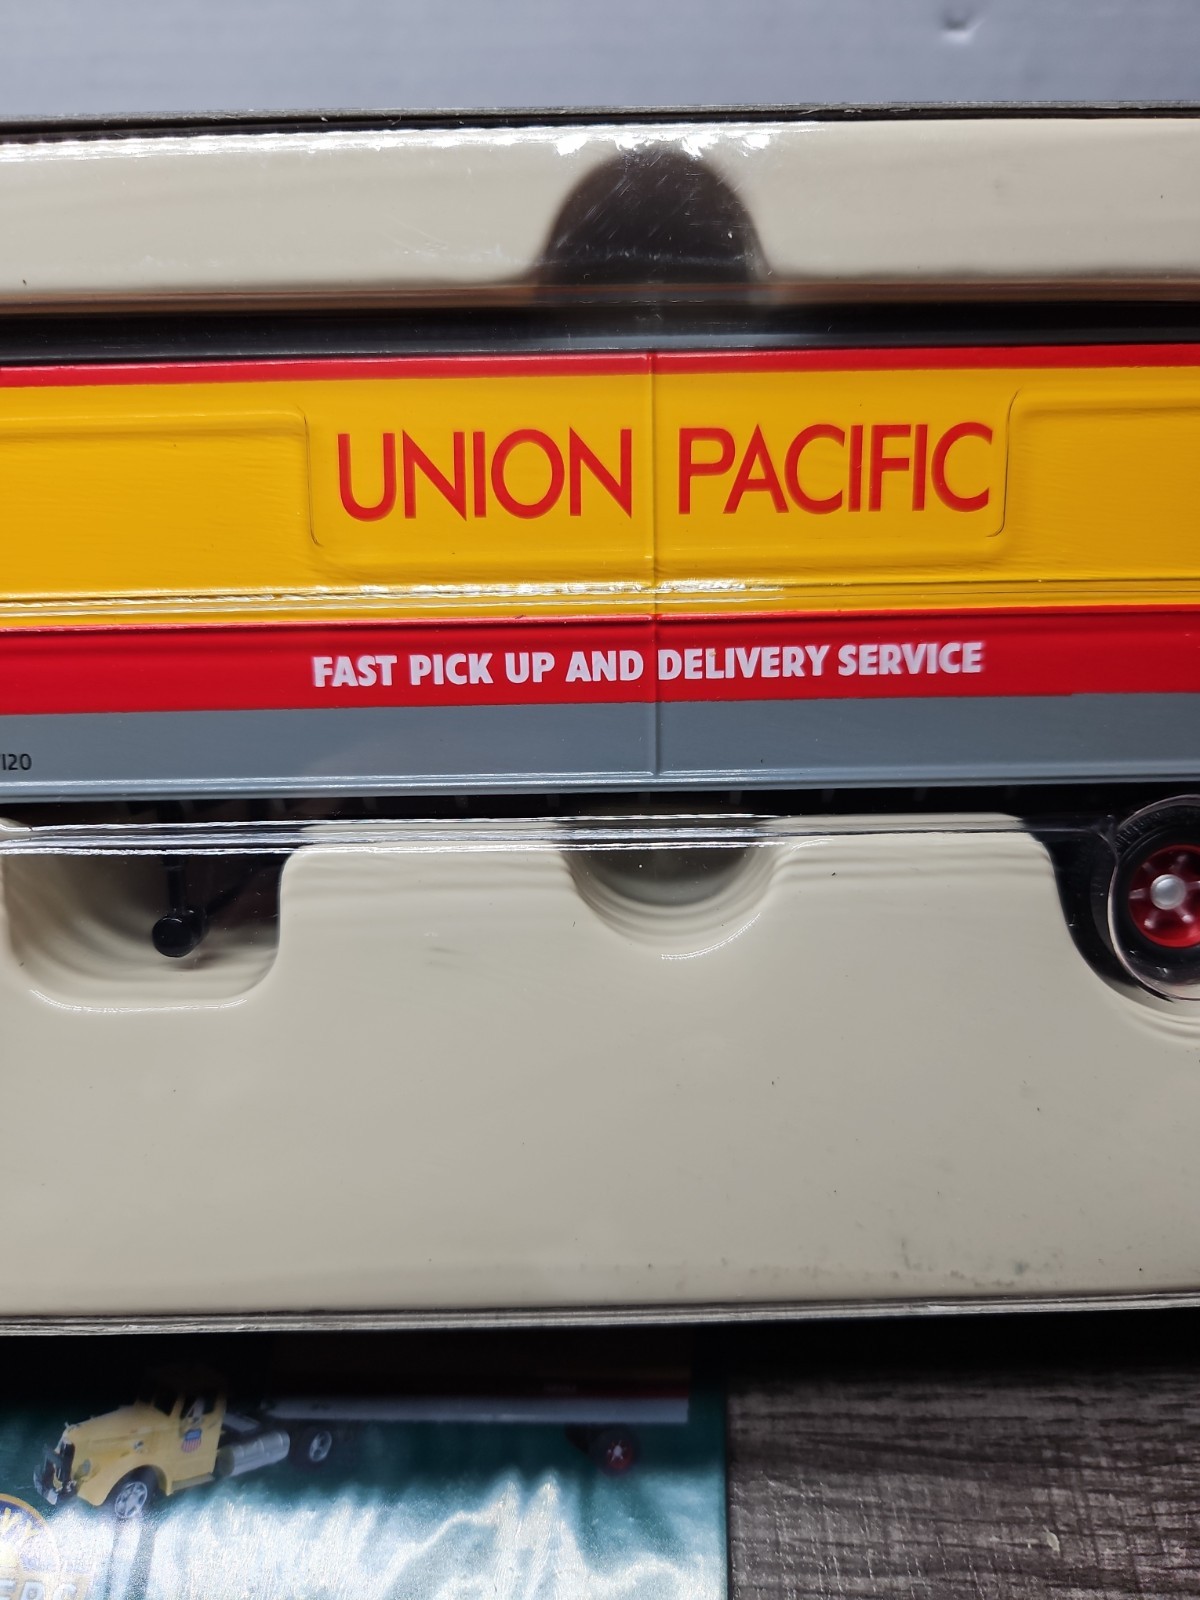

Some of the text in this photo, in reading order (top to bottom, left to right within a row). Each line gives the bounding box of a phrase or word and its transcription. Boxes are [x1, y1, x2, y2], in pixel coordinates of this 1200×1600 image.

[338, 422, 995, 523] UNION PACIFIC
[312, 643, 984, 689] FAST PICK UP AND DELIVERY SERVICE
[0, 753, 33, 771] 120
